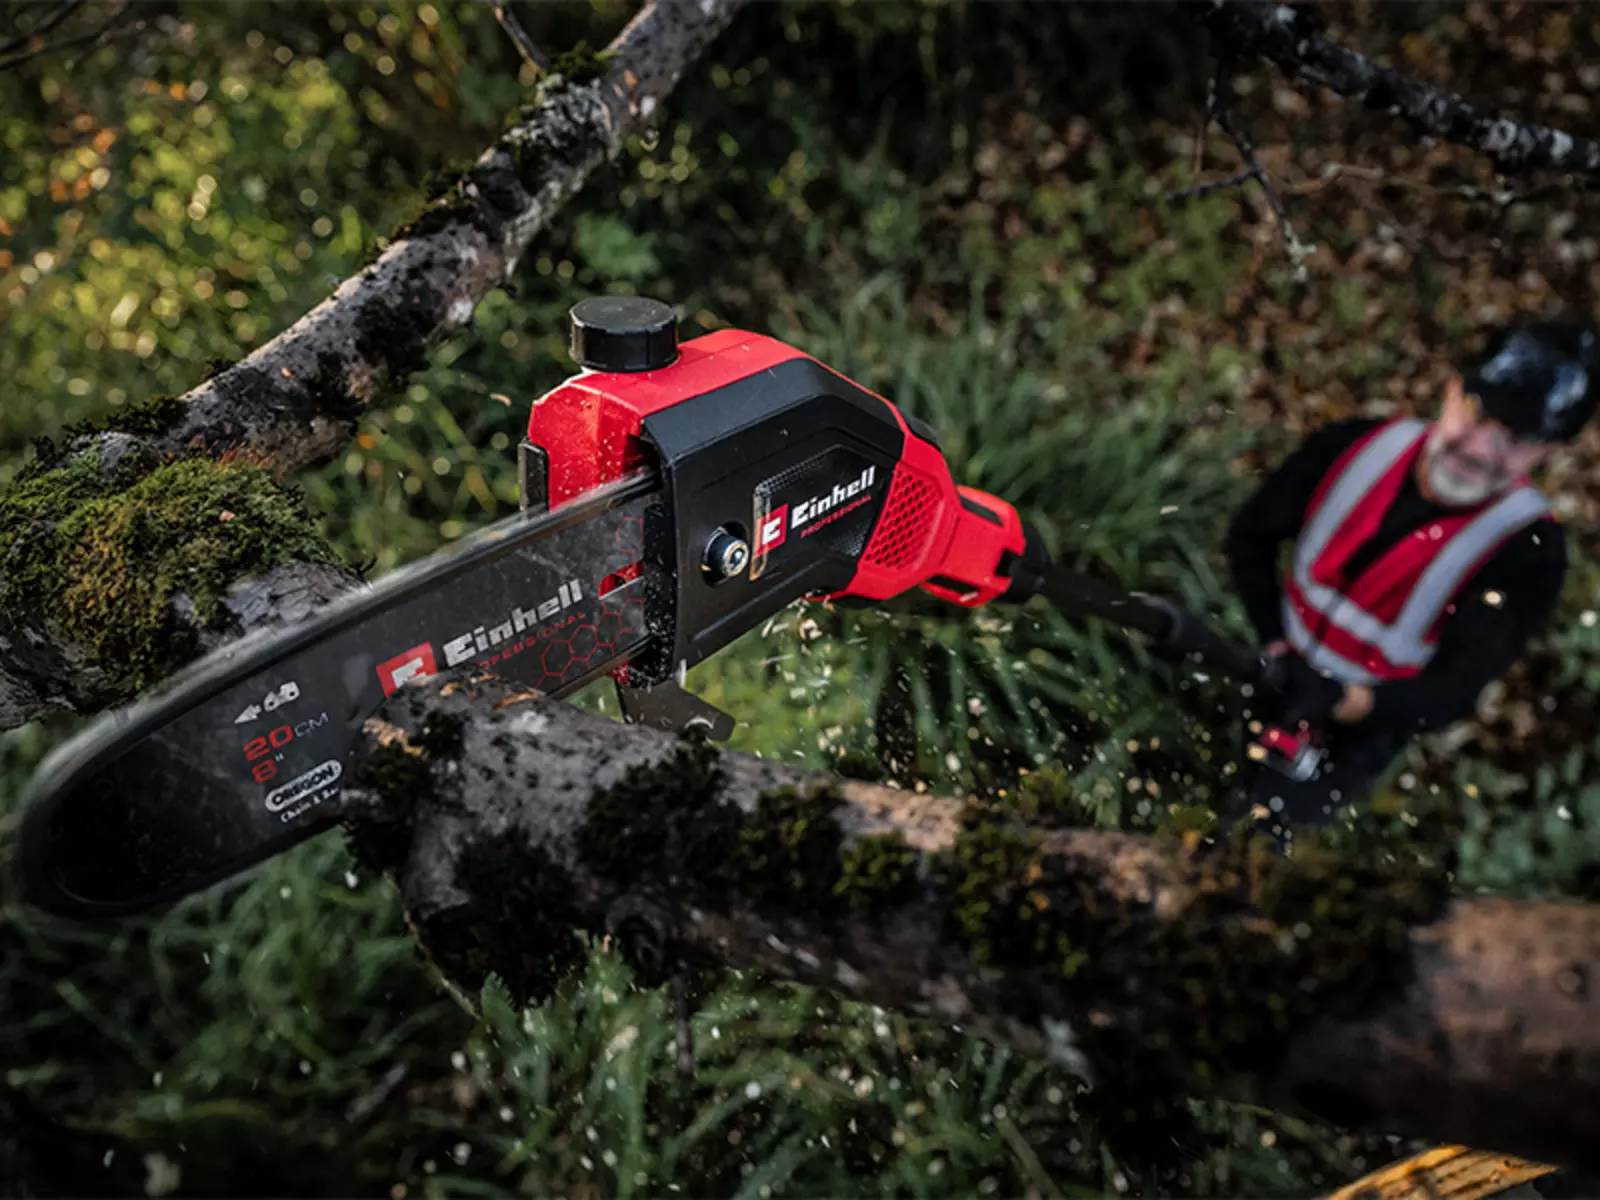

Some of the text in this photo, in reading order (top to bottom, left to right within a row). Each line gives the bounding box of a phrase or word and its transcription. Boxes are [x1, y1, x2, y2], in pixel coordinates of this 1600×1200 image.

[791, 465, 875, 529] Einhell
[443, 579, 583, 667] Einhell
[272, 765, 334, 805] OREGON
